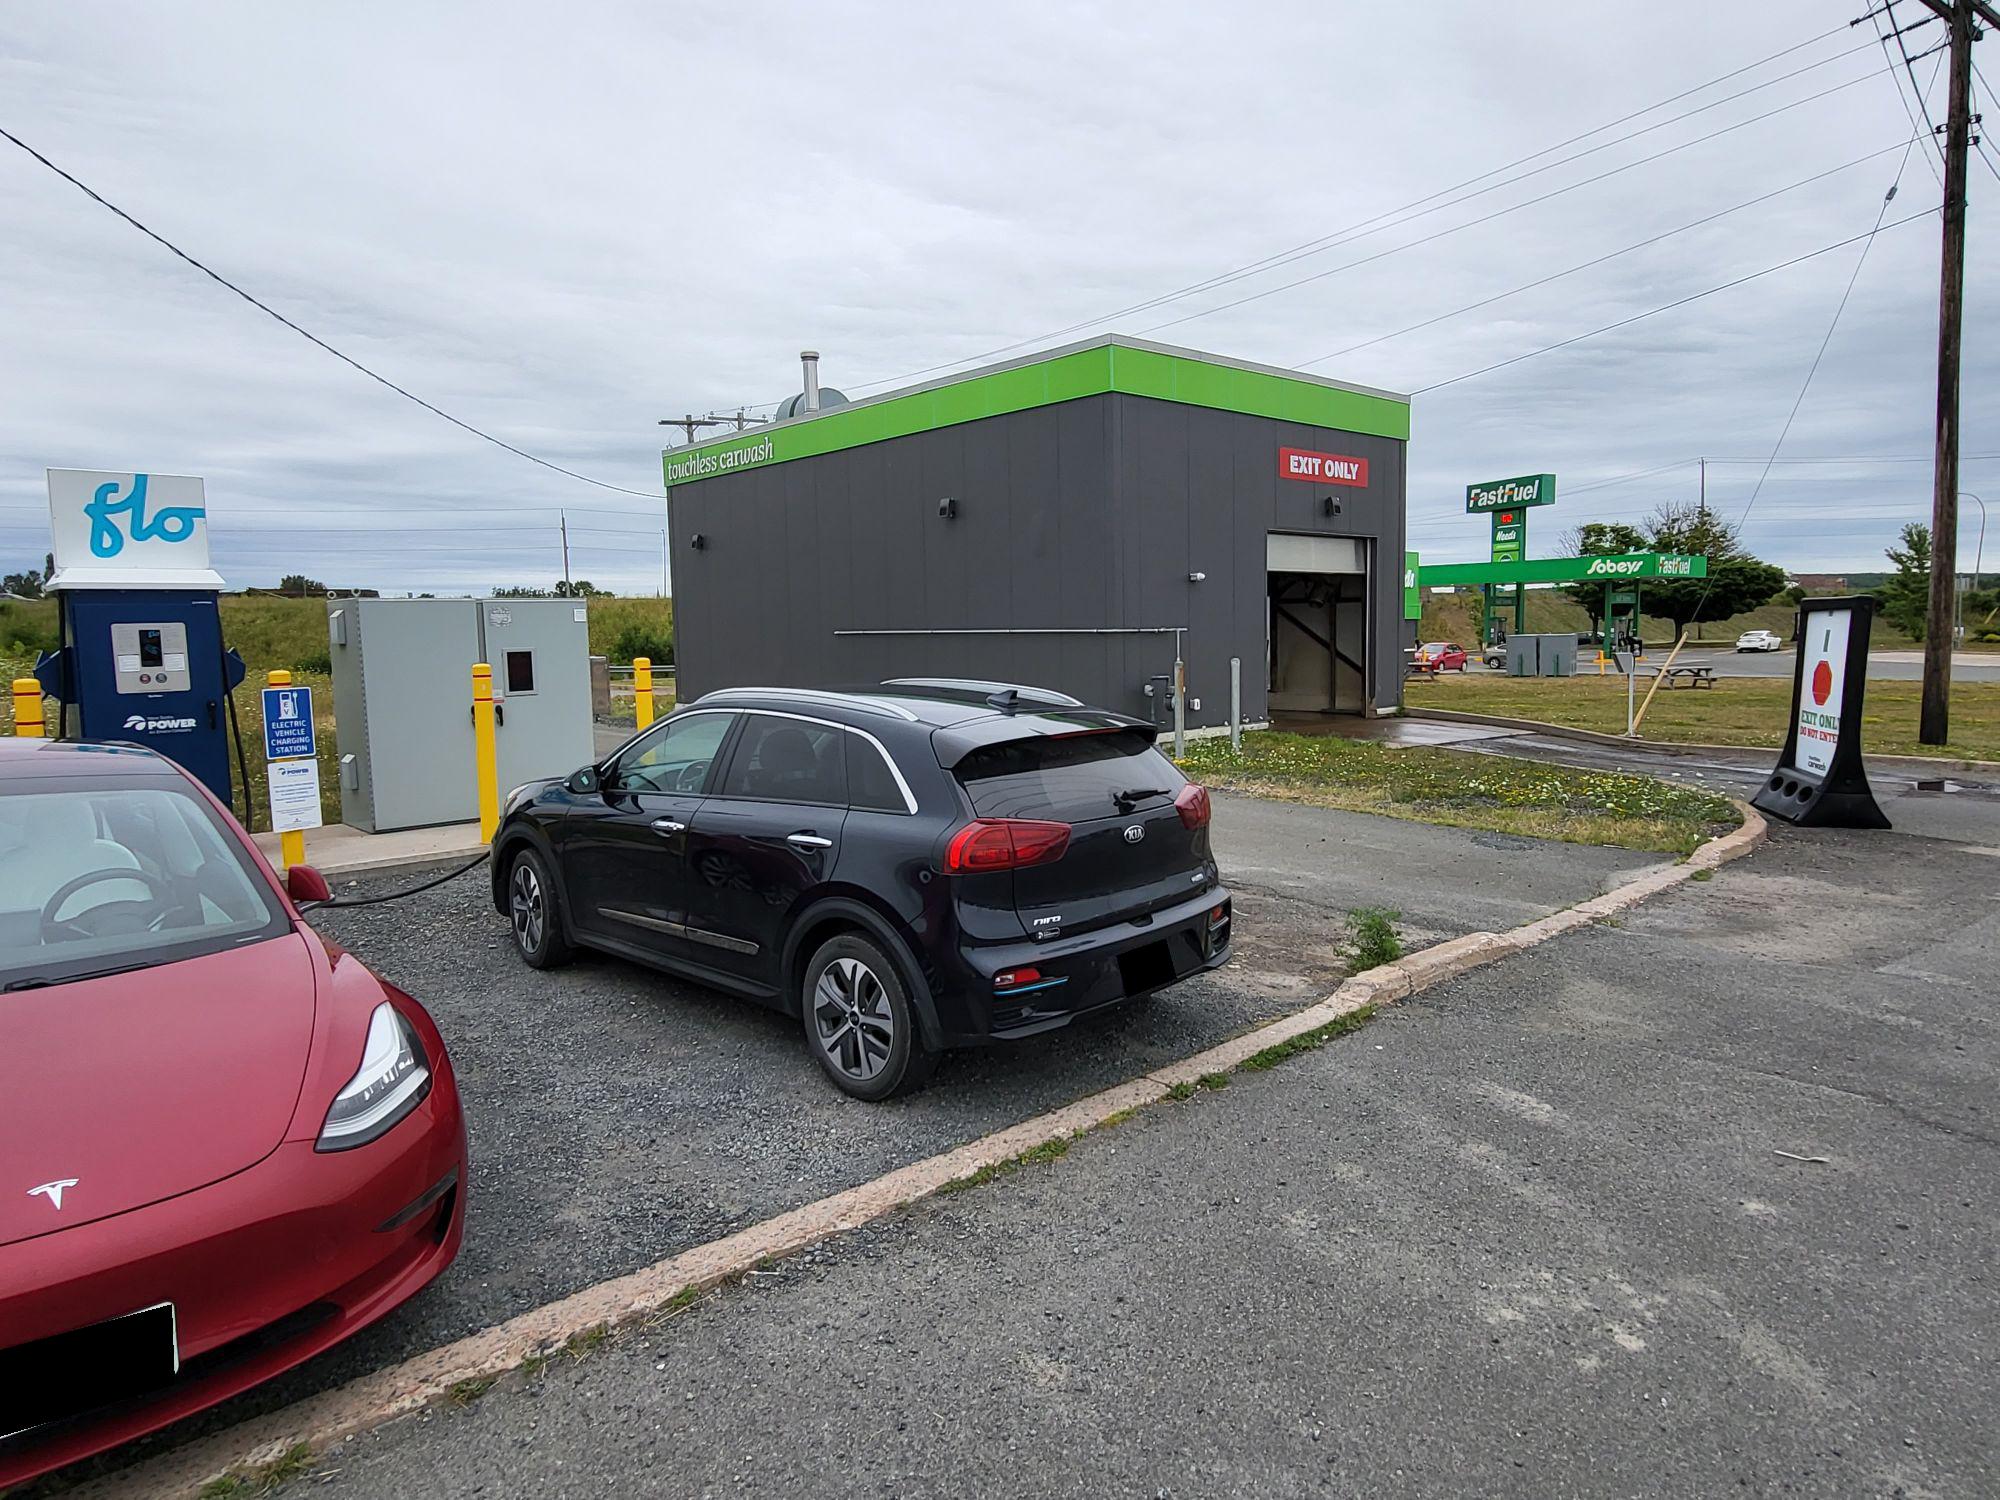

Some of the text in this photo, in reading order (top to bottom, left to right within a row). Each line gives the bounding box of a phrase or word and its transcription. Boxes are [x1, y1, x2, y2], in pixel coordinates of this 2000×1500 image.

[668, 436, 773, 480] touchless carwash
[1289, 454, 1359, 480] EXIT ONLY
[1469, 480, 1540, 508] FastFuel
[84, 474, 206, 558] flo
[1587, 558, 1644, 575] Sobeys
[147, 718, 197, 730] POWER
[271, 720, 307, 729] ELECTRIC
[1801, 710, 1818, 726] EXIT
[275, 728, 306, 737] VEHICLE
[271, 736, 311, 746] CHARGING
[275, 745, 308, 754] STATION
[1128, 828, 1144, 840] KIA
